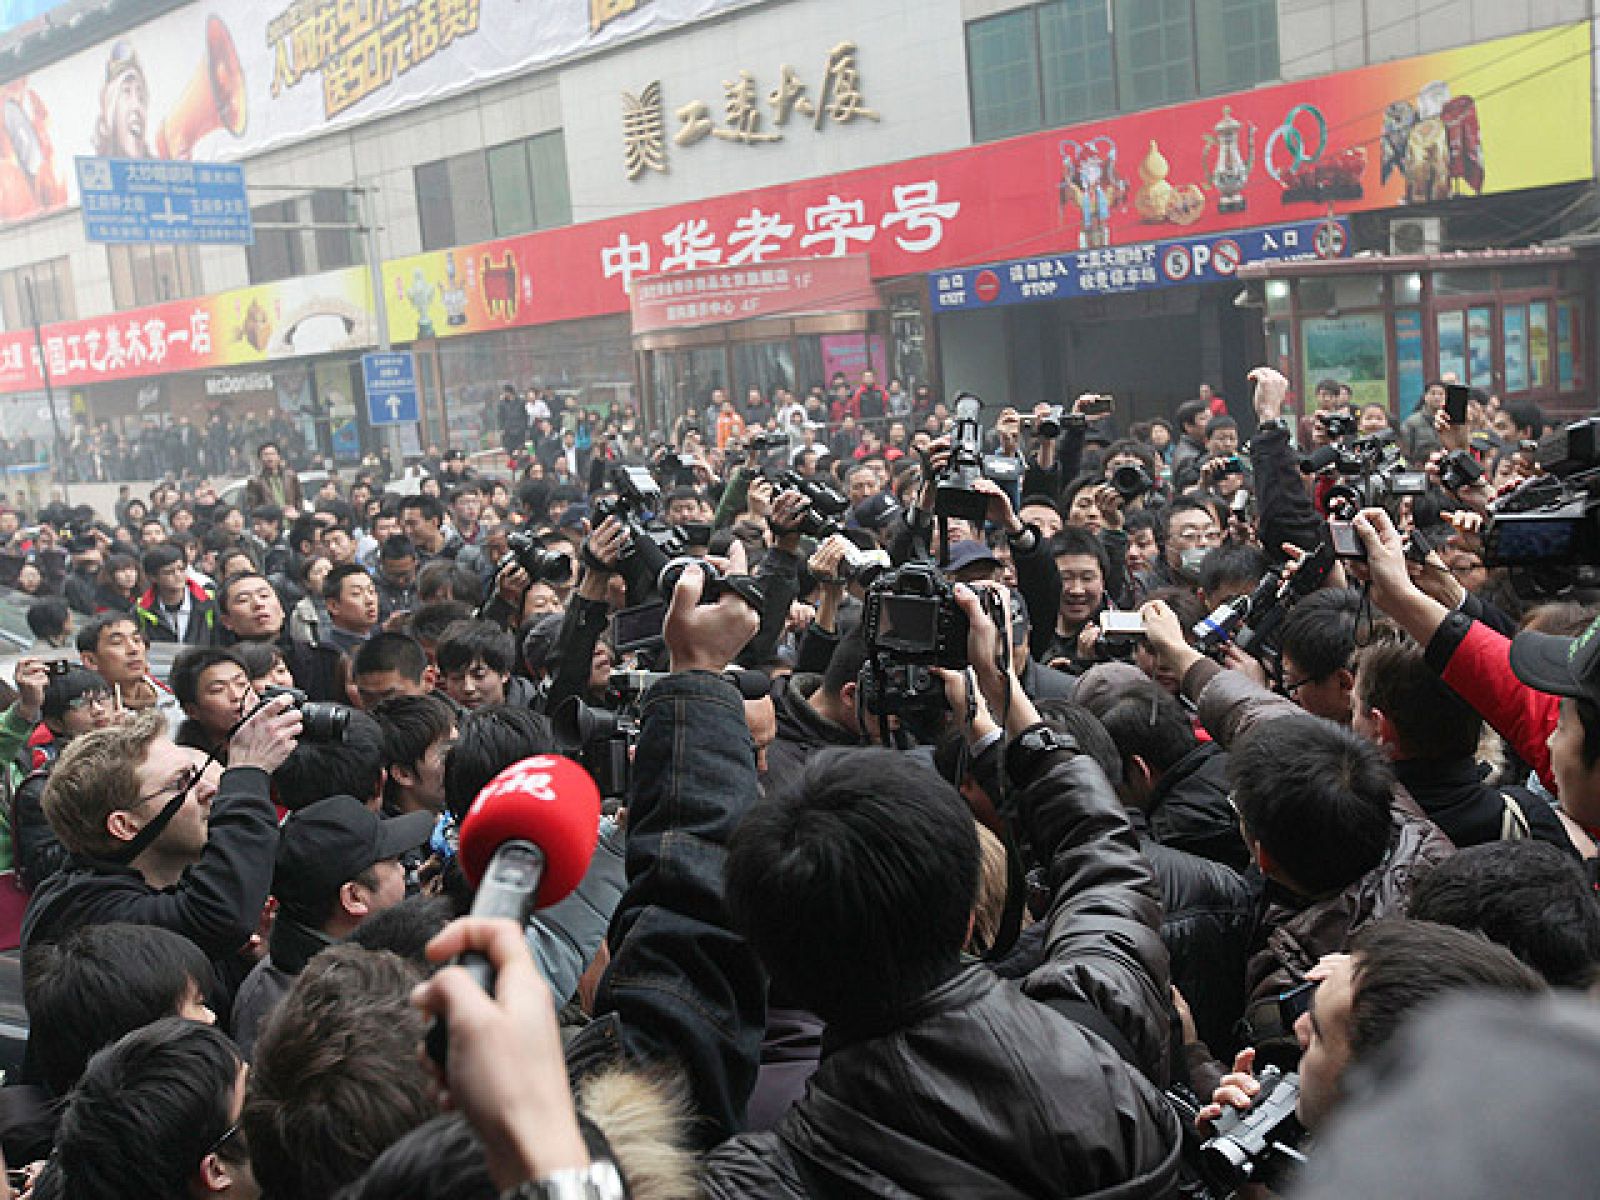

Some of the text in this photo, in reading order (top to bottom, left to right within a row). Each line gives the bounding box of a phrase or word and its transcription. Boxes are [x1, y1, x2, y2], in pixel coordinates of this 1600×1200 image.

[601, 180, 960, 294] 中华老字号
[1262, 230, 1299, 251] 入口
[1192, 245, 1211, 276] P
[937, 274, 964, 291] 出口
[1021, 281, 1058, 297] STOP
[31, 308, 211, 378] 中国工艺美术第一店
